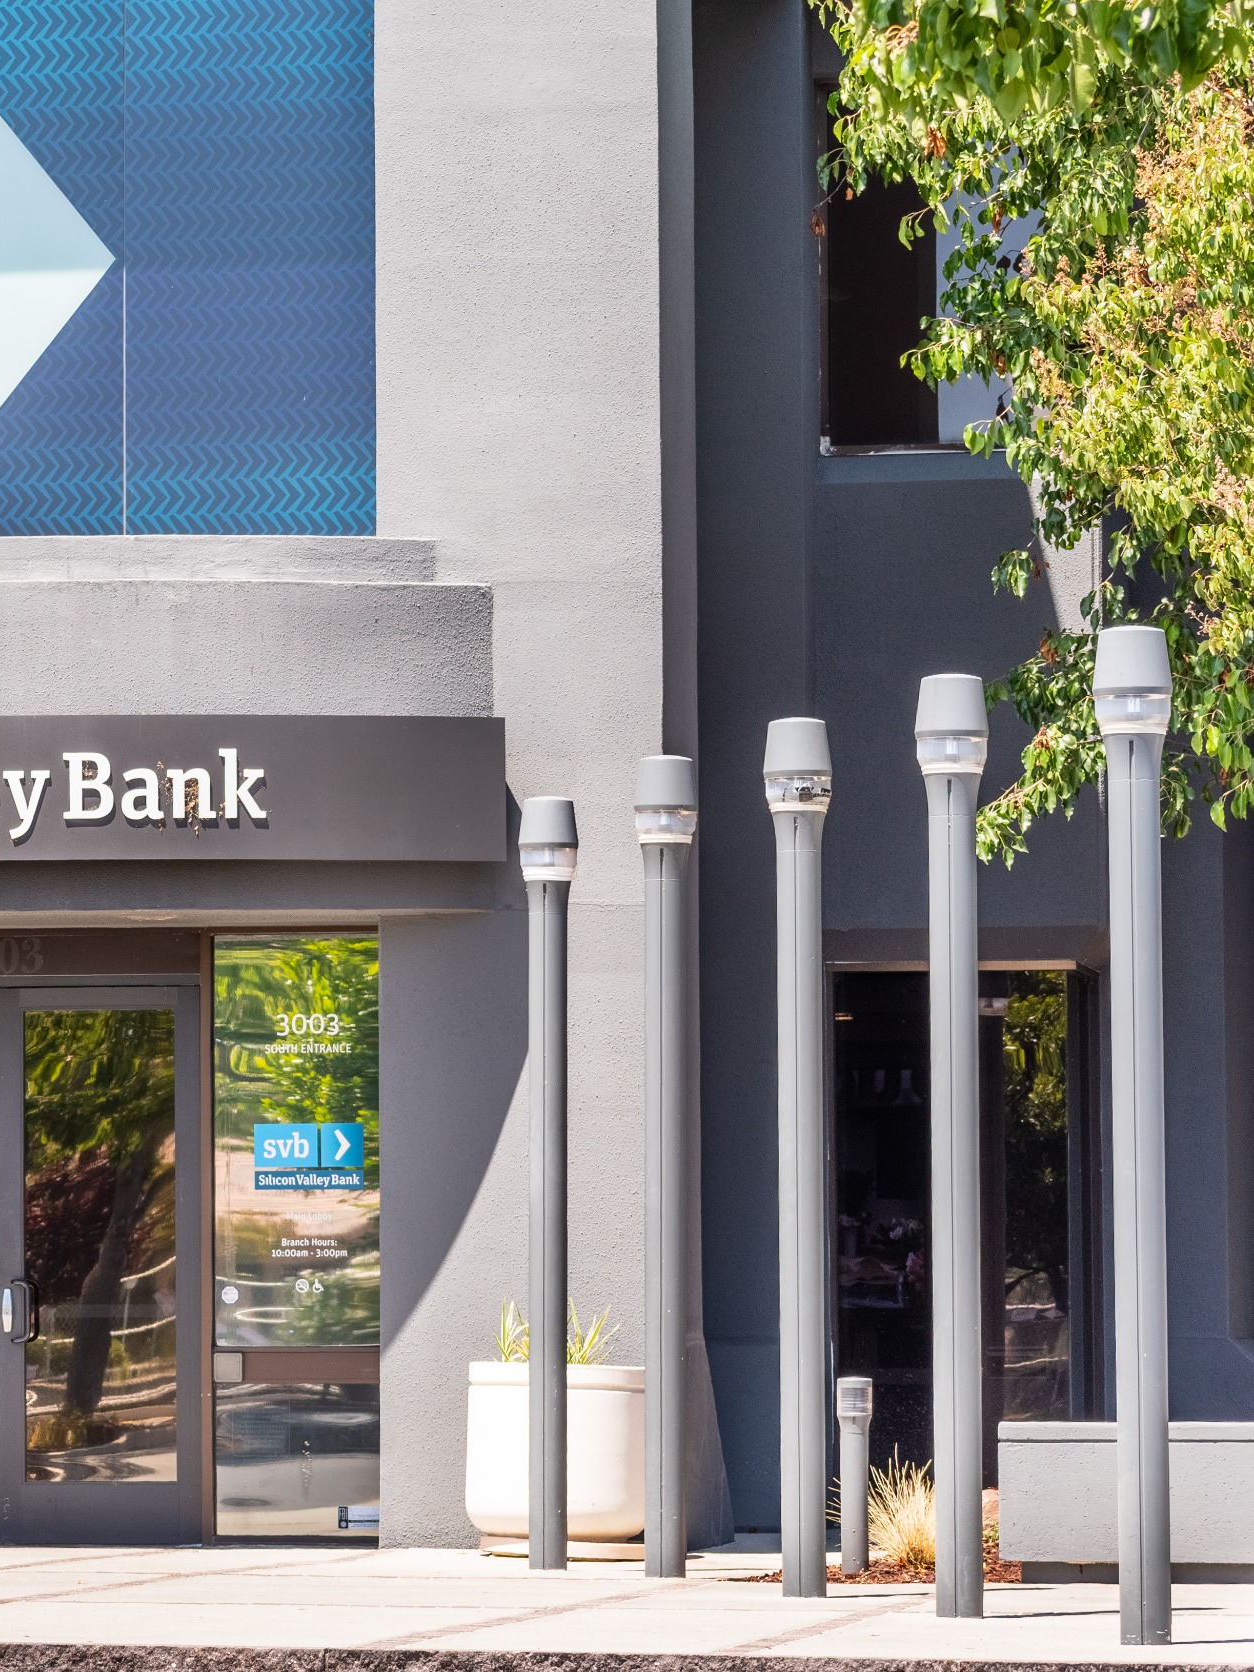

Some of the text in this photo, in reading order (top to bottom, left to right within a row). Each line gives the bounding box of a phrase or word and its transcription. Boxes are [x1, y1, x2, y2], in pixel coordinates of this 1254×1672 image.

[62, 747, 269, 826] Bank
[276, 1013, 340, 1037] 3003
[264, 1043, 352, 1055] SOUTH ENTRANCE
[263, 1132, 310, 1159] svb
[258, 1173, 360, 1188] Silicon Valley Bank
[309, 1211, 333, 1222] Lobby
[281, 1238, 338, 1247] Branch Hours:
[271, 1249, 309, 1258] 10:00am
[315, 1249, 348, 1259] 3:00pm
